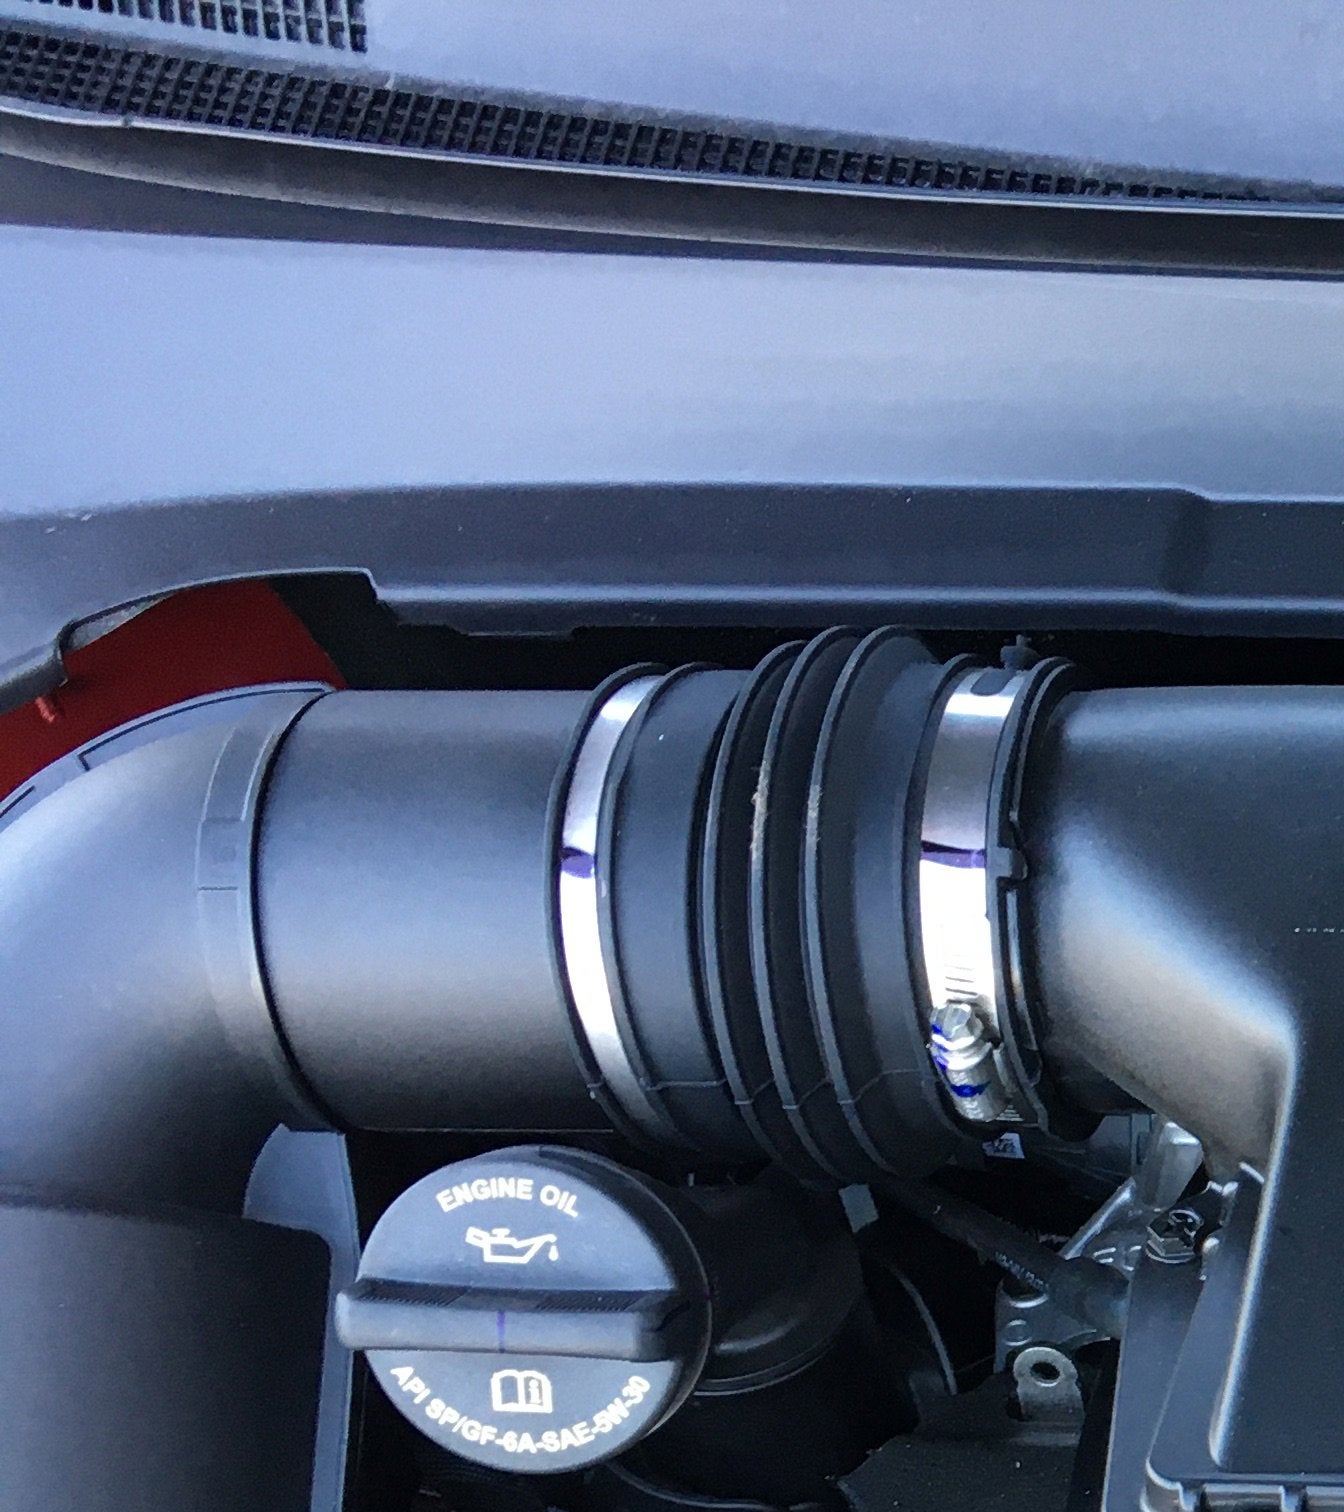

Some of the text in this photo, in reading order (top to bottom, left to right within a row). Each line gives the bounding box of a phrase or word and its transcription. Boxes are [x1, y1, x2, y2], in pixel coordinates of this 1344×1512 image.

[436, 1177, 579, 1218] ENGINE OIL
[390, 1366, 652, 1454] API SP/GF-6A-SAE-5W-30
